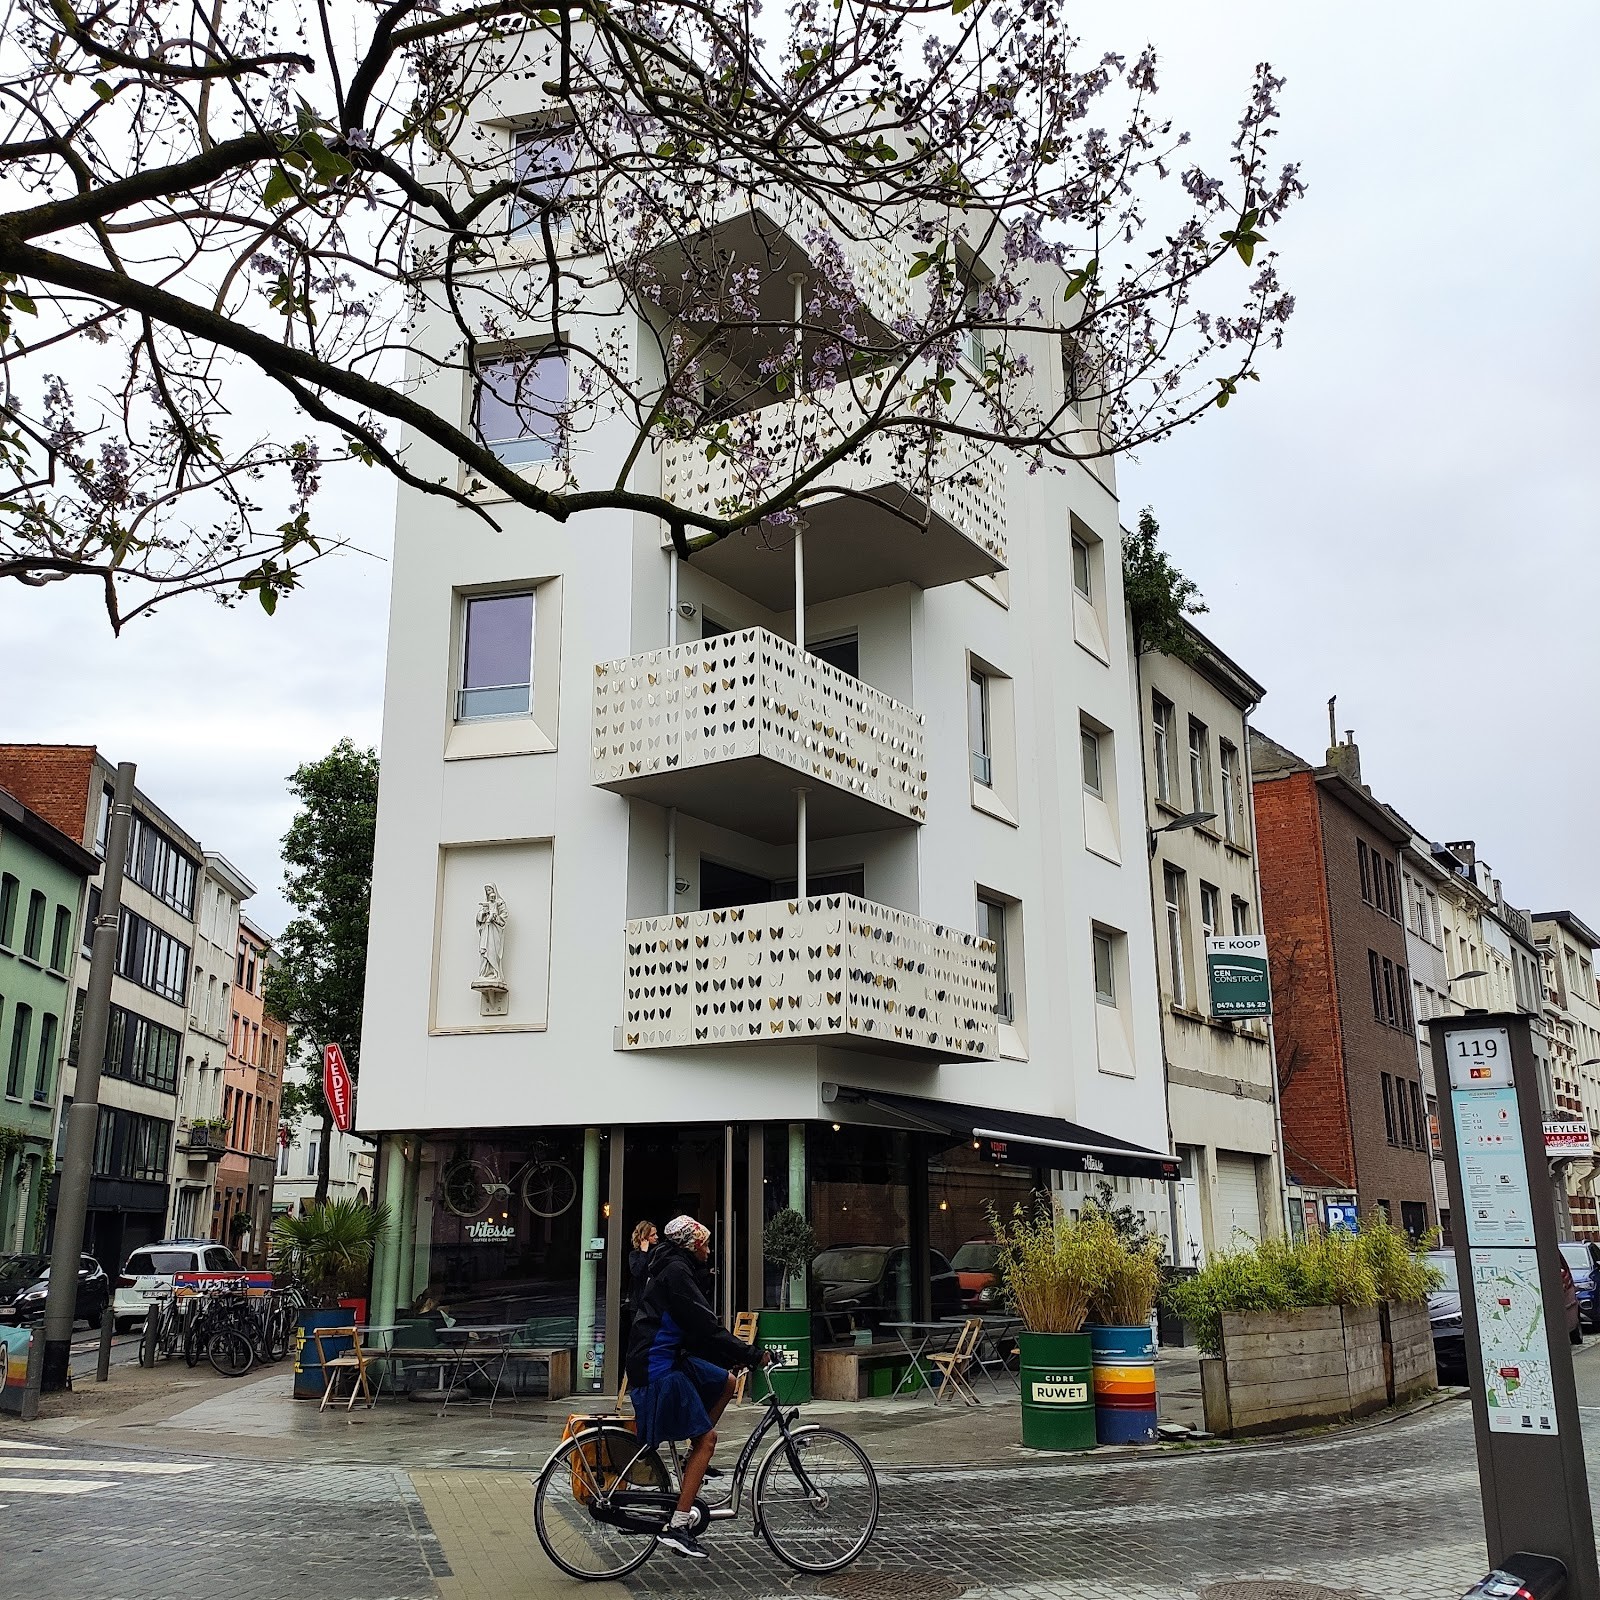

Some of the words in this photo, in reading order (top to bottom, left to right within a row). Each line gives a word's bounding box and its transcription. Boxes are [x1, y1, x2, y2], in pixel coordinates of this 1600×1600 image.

[1212, 941, 1225, 950] TE
[1229, 940, 1261, 949] KOOP
[1214, 975, 1264, 983] CONSTRUCT
[1457, 1039, 1498, 1058] 119
[327, 1050, 347, 1126] VEDETT
[1544, 1125, 1586, 1133] HEYLEN
[465, 1222, 515, 1237] Vitesse
